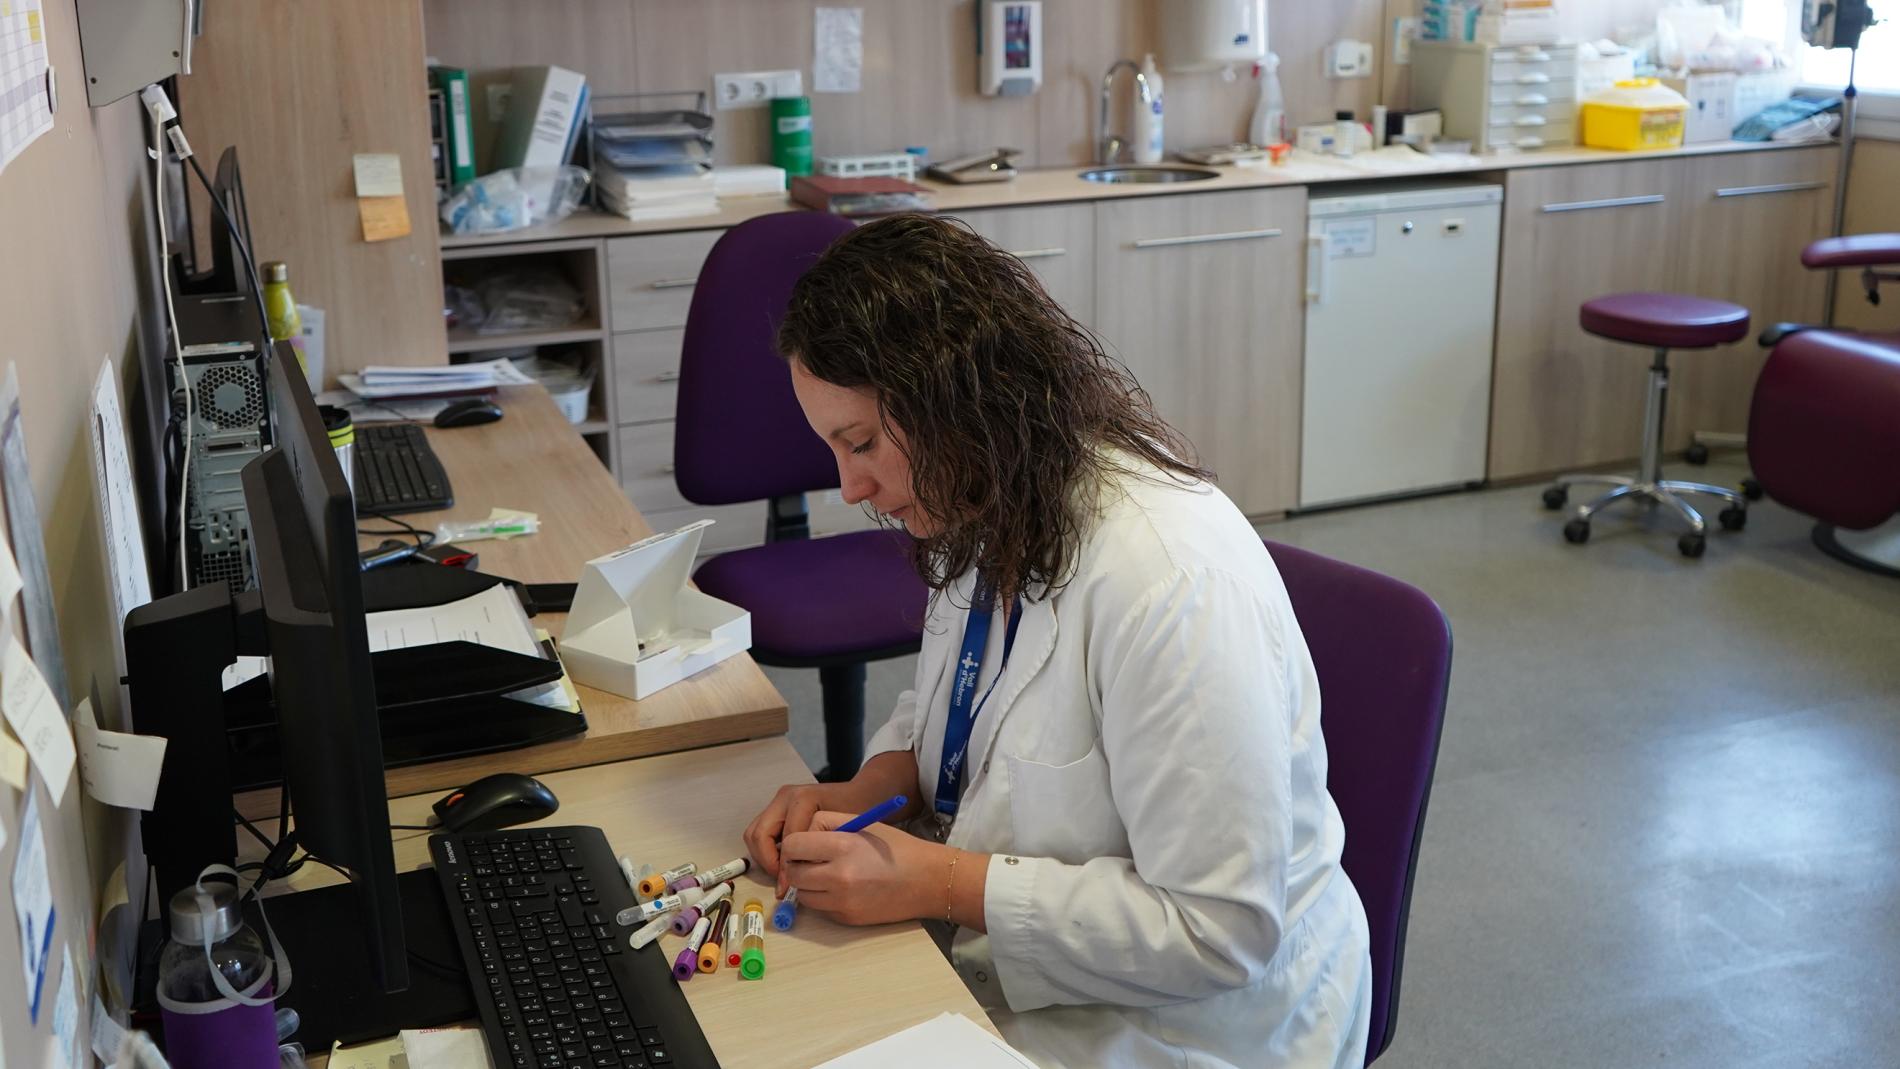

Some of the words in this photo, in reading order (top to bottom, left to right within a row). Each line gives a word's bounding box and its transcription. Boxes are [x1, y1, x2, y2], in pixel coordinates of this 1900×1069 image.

[956, 669, 968, 706] d'Hebron
[966, 672, 976, 687] Vall
[444, 840, 457, 864] lenovo
